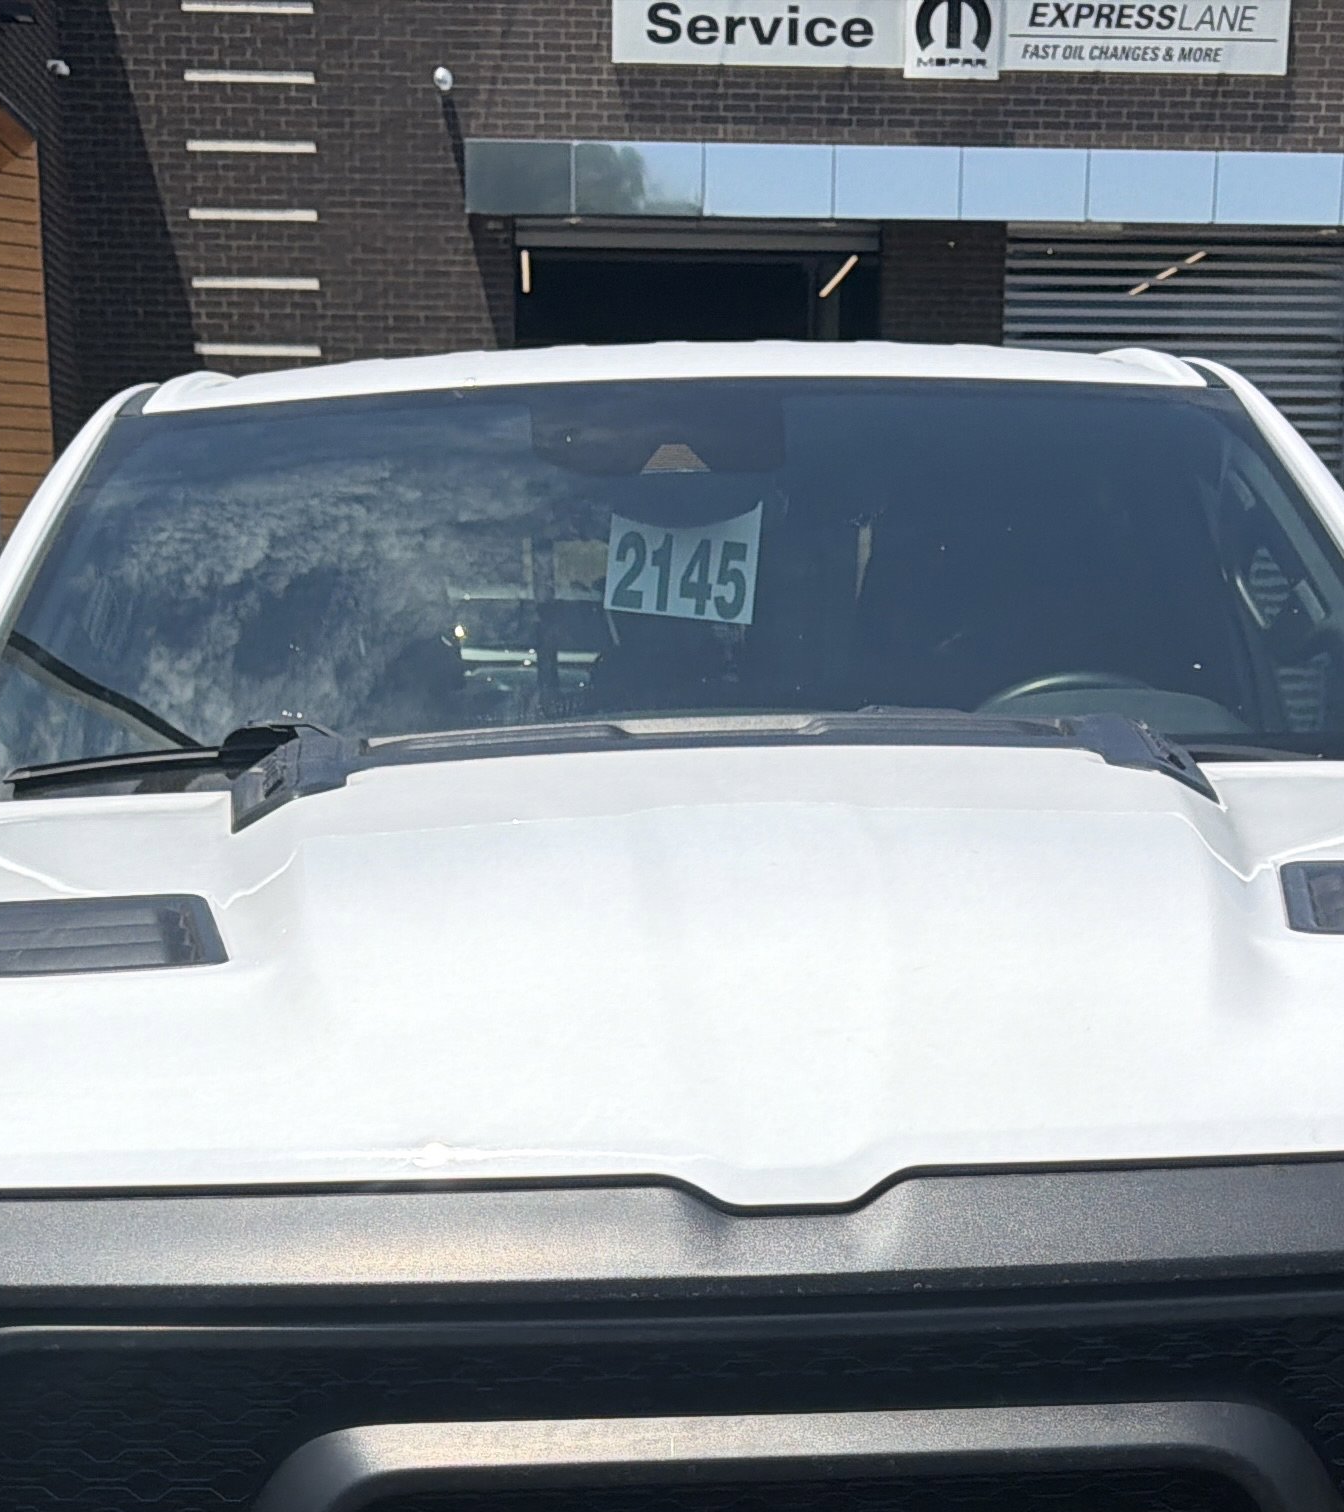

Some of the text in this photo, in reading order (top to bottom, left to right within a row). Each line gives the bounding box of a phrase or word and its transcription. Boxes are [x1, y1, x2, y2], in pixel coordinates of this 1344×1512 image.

[646, 2, 874, 48] Service
[1021, 44, 1223, 63] FAST OIL CHANGES & MORE
[611, 530, 748, 620] 2145
